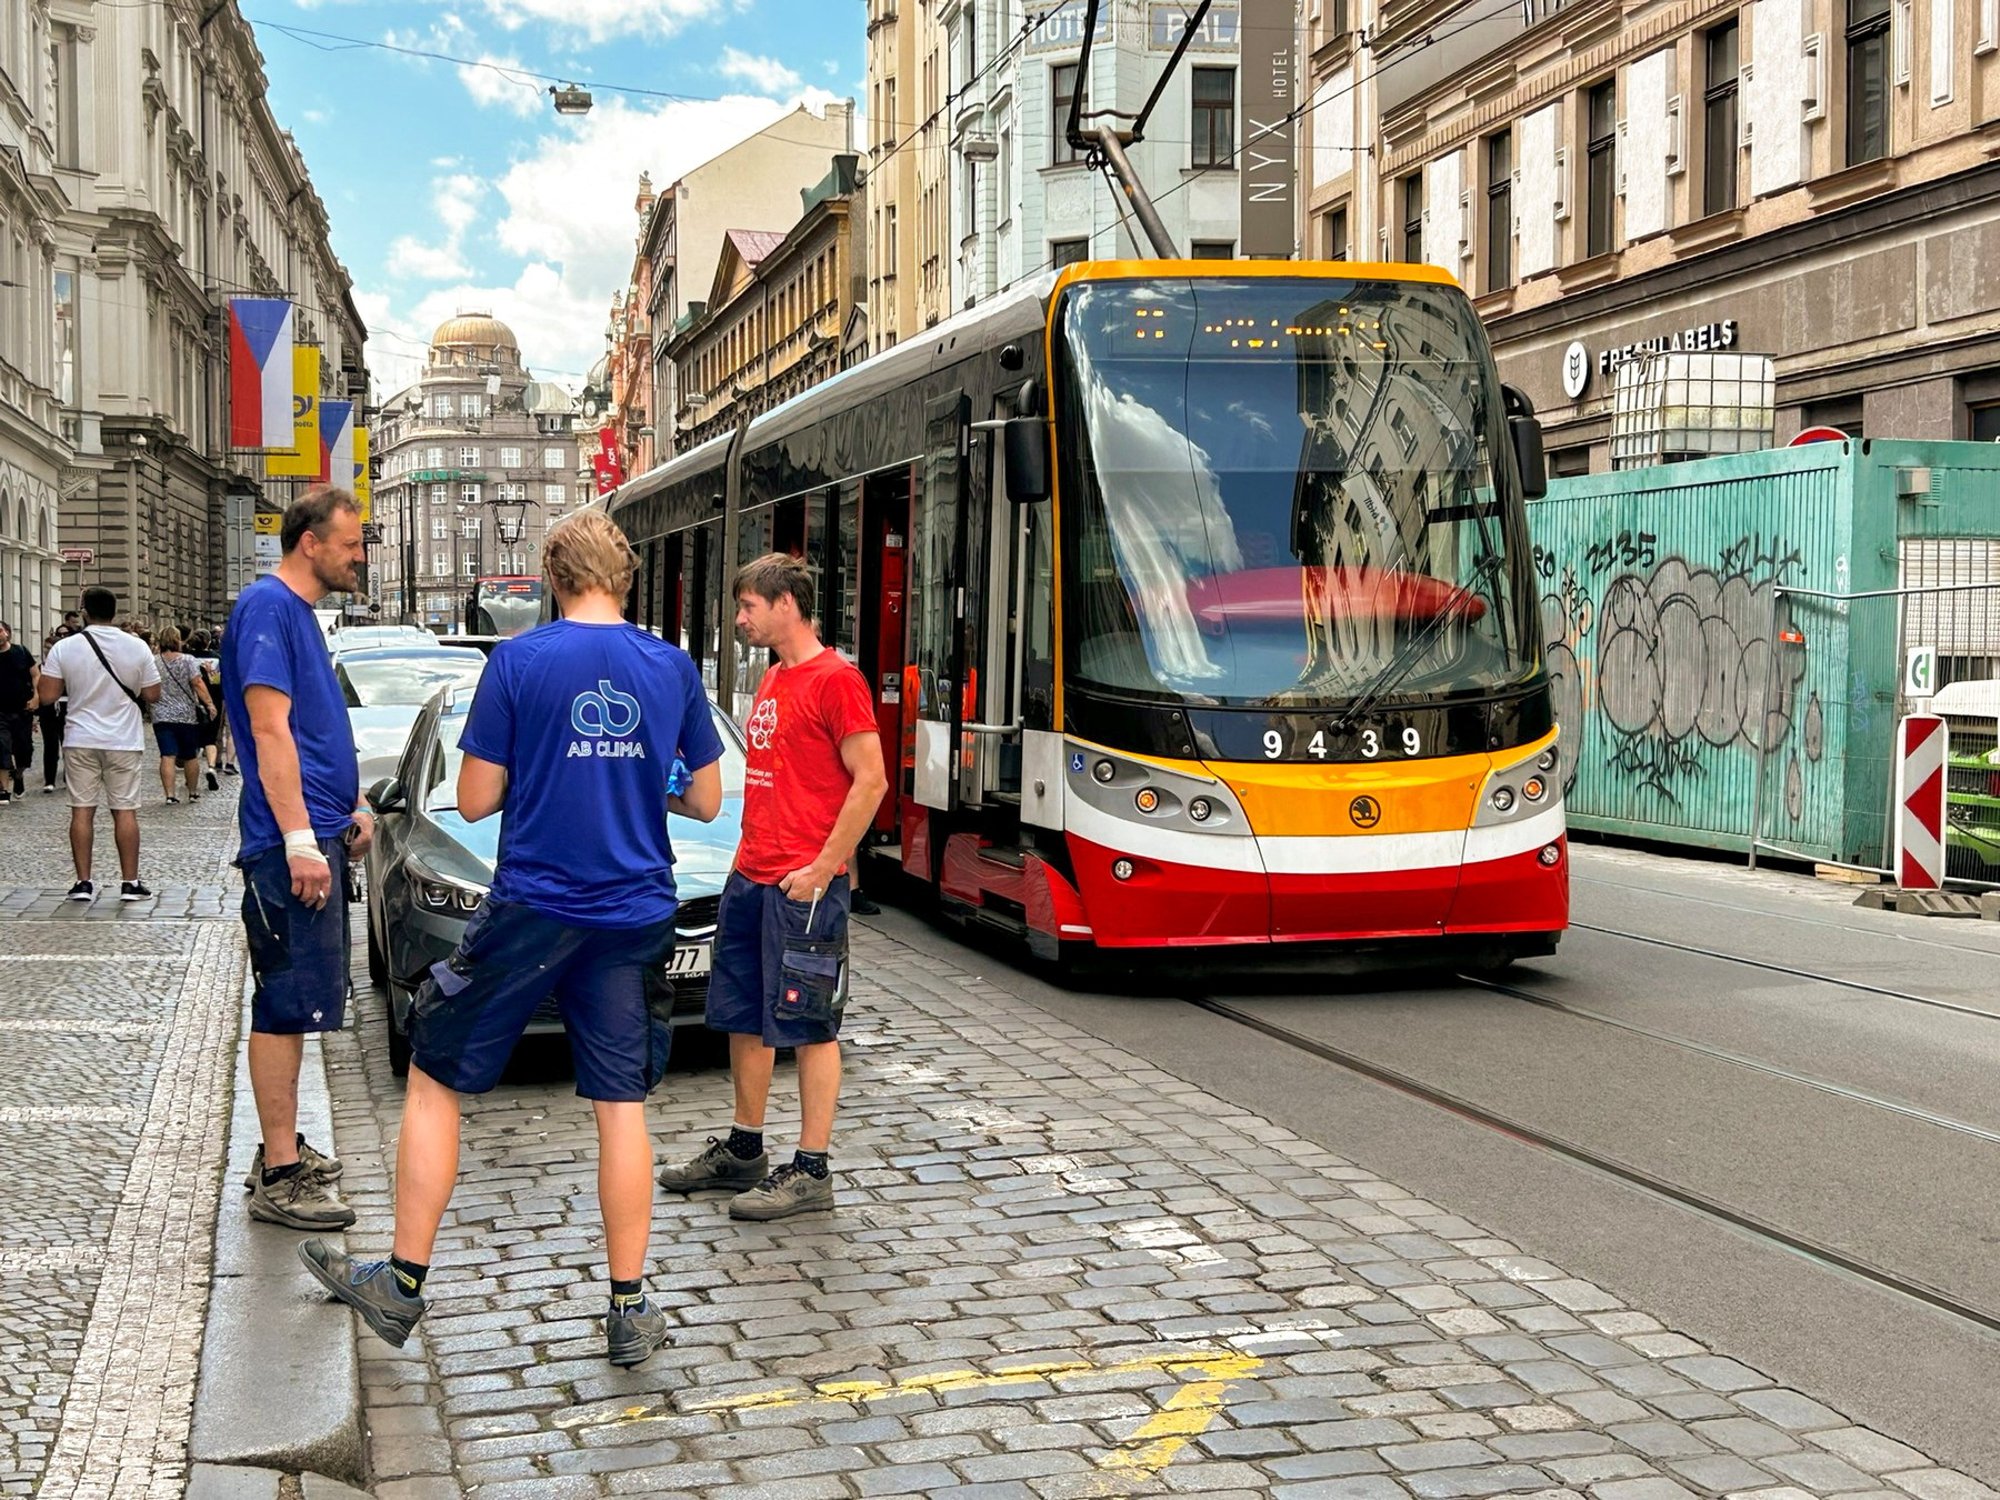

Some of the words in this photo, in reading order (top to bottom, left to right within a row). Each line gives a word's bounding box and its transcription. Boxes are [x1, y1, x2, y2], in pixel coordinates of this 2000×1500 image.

[1249, 118, 1287, 202] NYX
[1272, 48, 1287, 98] HOTEL
[567, 741, 593, 758] AB
[596, 741, 646, 759] CLIMA
